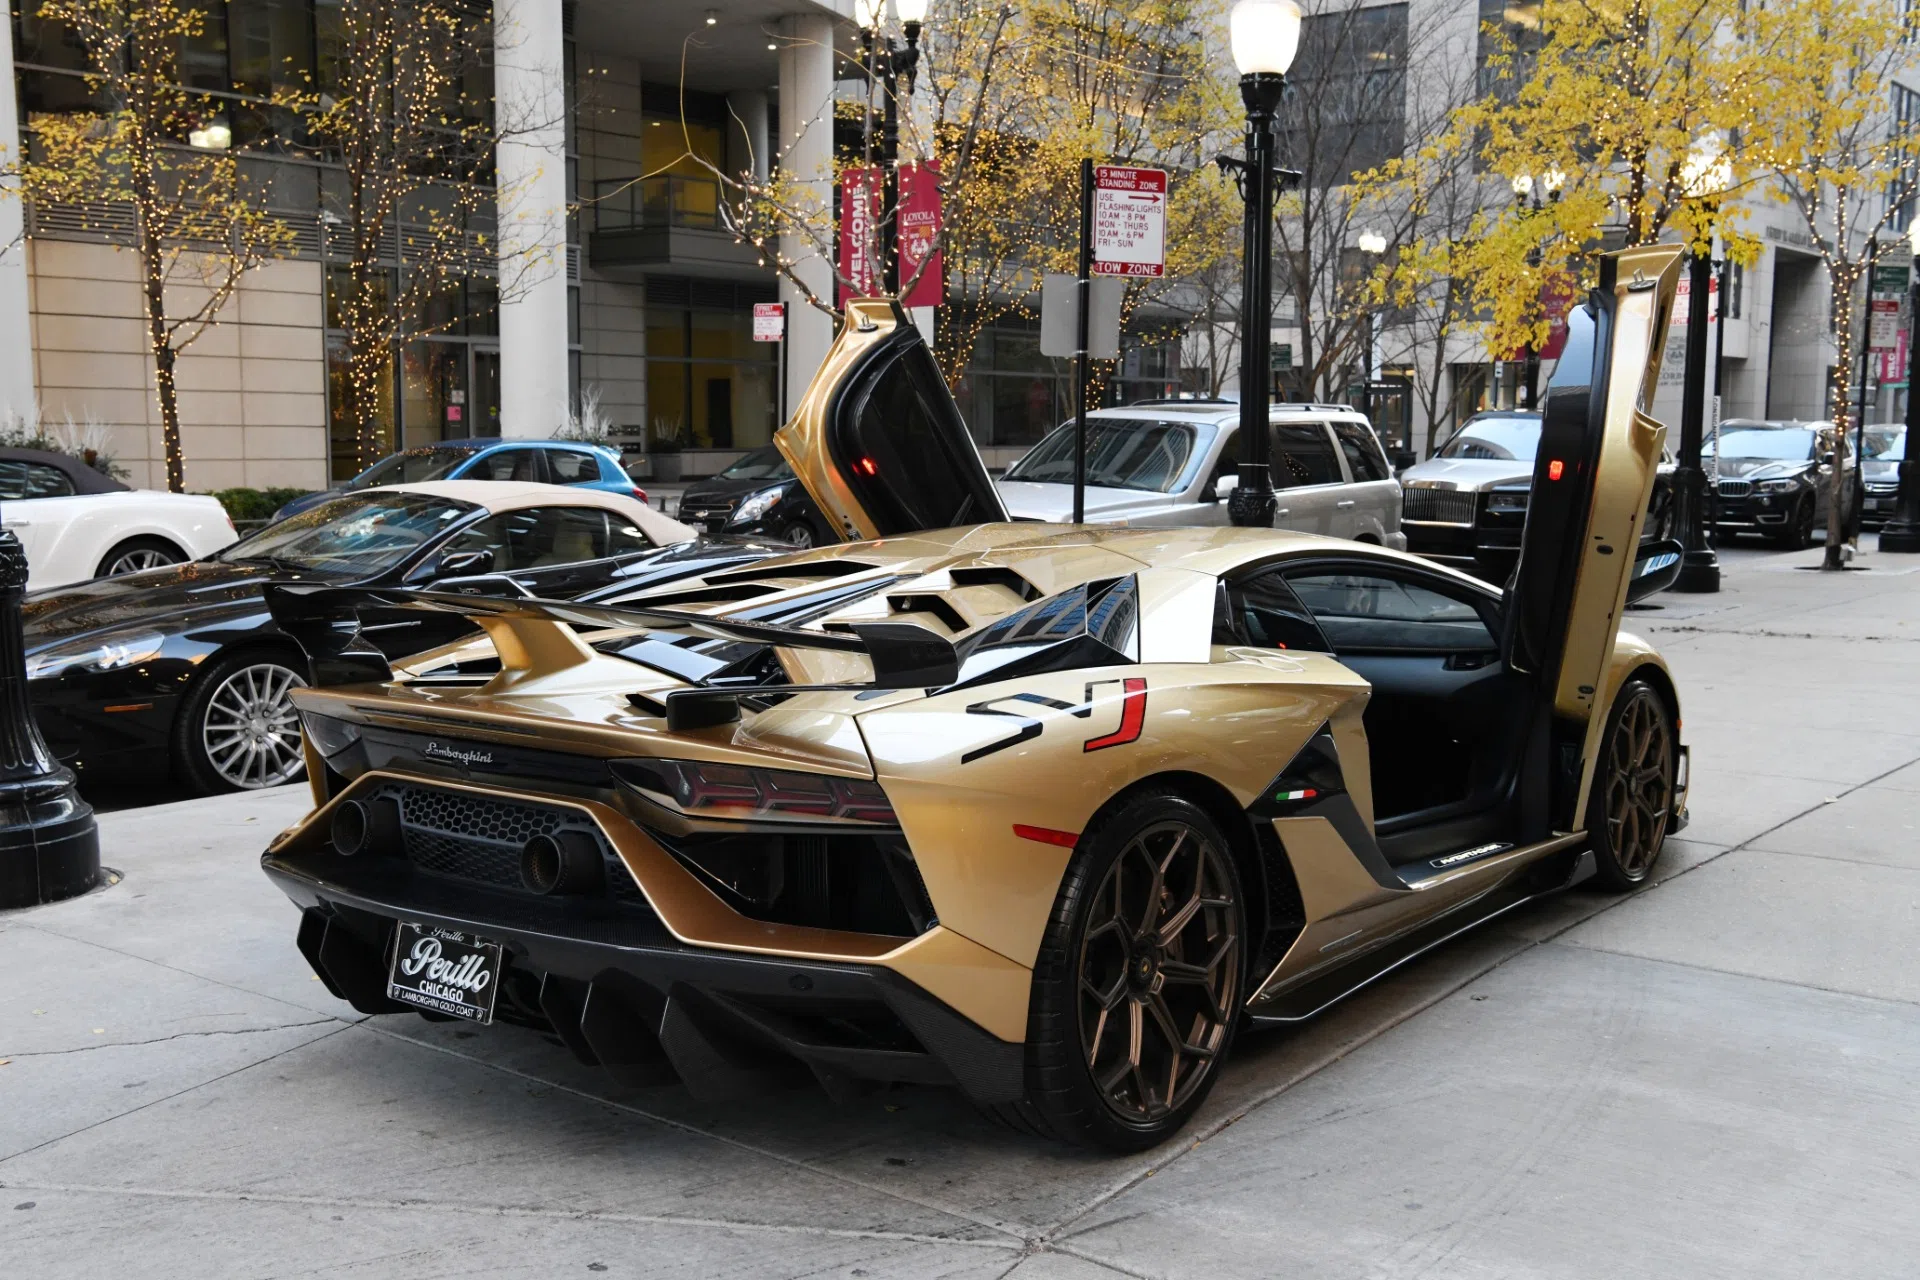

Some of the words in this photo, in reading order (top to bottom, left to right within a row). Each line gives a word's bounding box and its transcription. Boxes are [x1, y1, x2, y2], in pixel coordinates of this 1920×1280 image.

[1100, 169, 1108, 178] 15
[1110, 170, 1137, 180] MINUTE
[1100, 179, 1136, 189] STANDING
[1139, 181, 1158, 191] ZONE
[1099, 193, 1114, 201] USE
[1099, 202, 1135, 212] FLASHING
[1136, 205, 1161, 214] LIGHTS
[903, 211, 935, 222] LOYOLA
[1099, 211, 1107, 219] 10
[1134, 213, 1145, 221] PM
[1098, 220, 1115, 229] MON
[1123, 221, 1149, 231] THURS
[851, 187, 864, 292] WELCOME
[1098, 229, 1106, 237] 10
[1126, 231, 1131, 239] 6
[1133, 231, 1144, 239] PM
[1098, 238, 1111, 246] FRI
[1117, 239, 1134, 248] SUN
[1098, 262, 1122, 273] TOW
[1127, 264, 1158, 275] ZONE
[425, 741, 493, 766] Lamborghini
[430, 927, 465, 941] Perillo
[401, 937, 490, 993] Perillo
[419, 980, 464, 1002] CHICAGO
[401, 990, 440, 1008] LAMBORGHINI
[439, 1001, 456, 1013] GOLD
[455, 1004, 474, 1018] COAST
